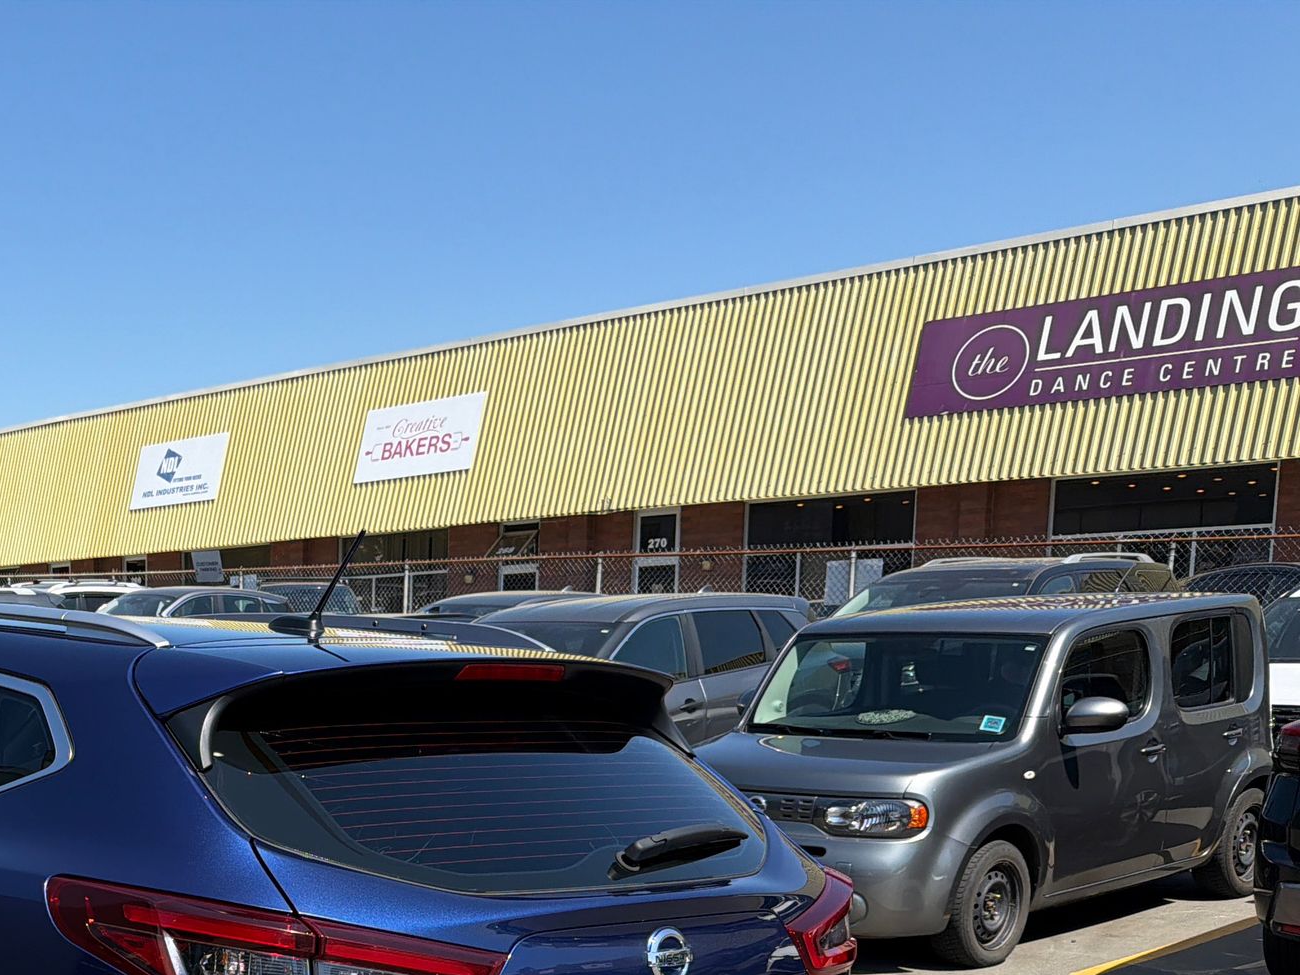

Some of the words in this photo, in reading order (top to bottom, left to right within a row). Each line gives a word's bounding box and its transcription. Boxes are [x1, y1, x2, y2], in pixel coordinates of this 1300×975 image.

[1037, 280, 1300, 361] LANDING
[968, 347, 1009, 376] the
[1029, 368, 1134, 397] DANCE
[1159, 349, 1296, 382] CENTRE
[392, 415, 447, 438] Creative
[381, 433, 452, 460] BAKERS
[160, 455, 179, 474] NDL
[156, 484, 194, 496] INDUSTRIES
[647, 537, 668, 549] 270
